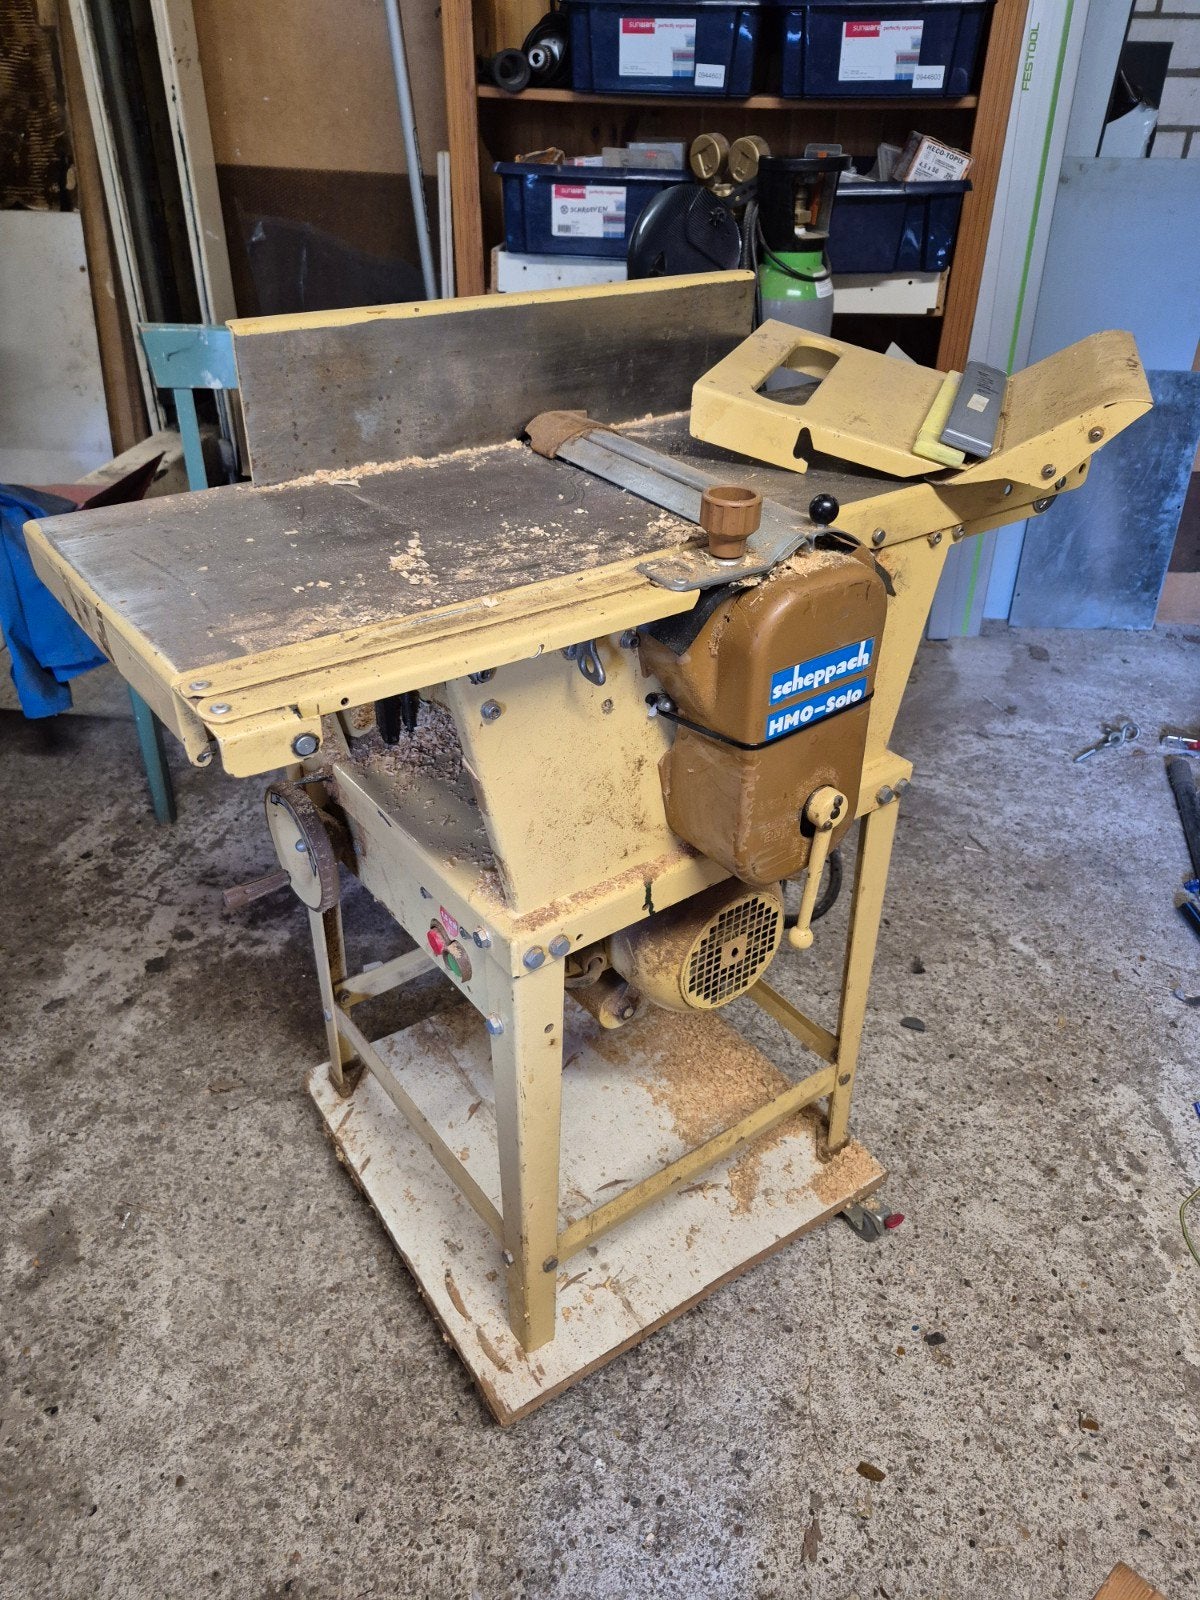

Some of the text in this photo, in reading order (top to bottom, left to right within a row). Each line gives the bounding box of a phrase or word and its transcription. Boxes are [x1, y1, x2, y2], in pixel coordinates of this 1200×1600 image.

[1021, 22, 1041, 91] FESTOOL
[772, 640, 870, 700] scheppach
[768, 688, 863, 736] HMO-Solo
